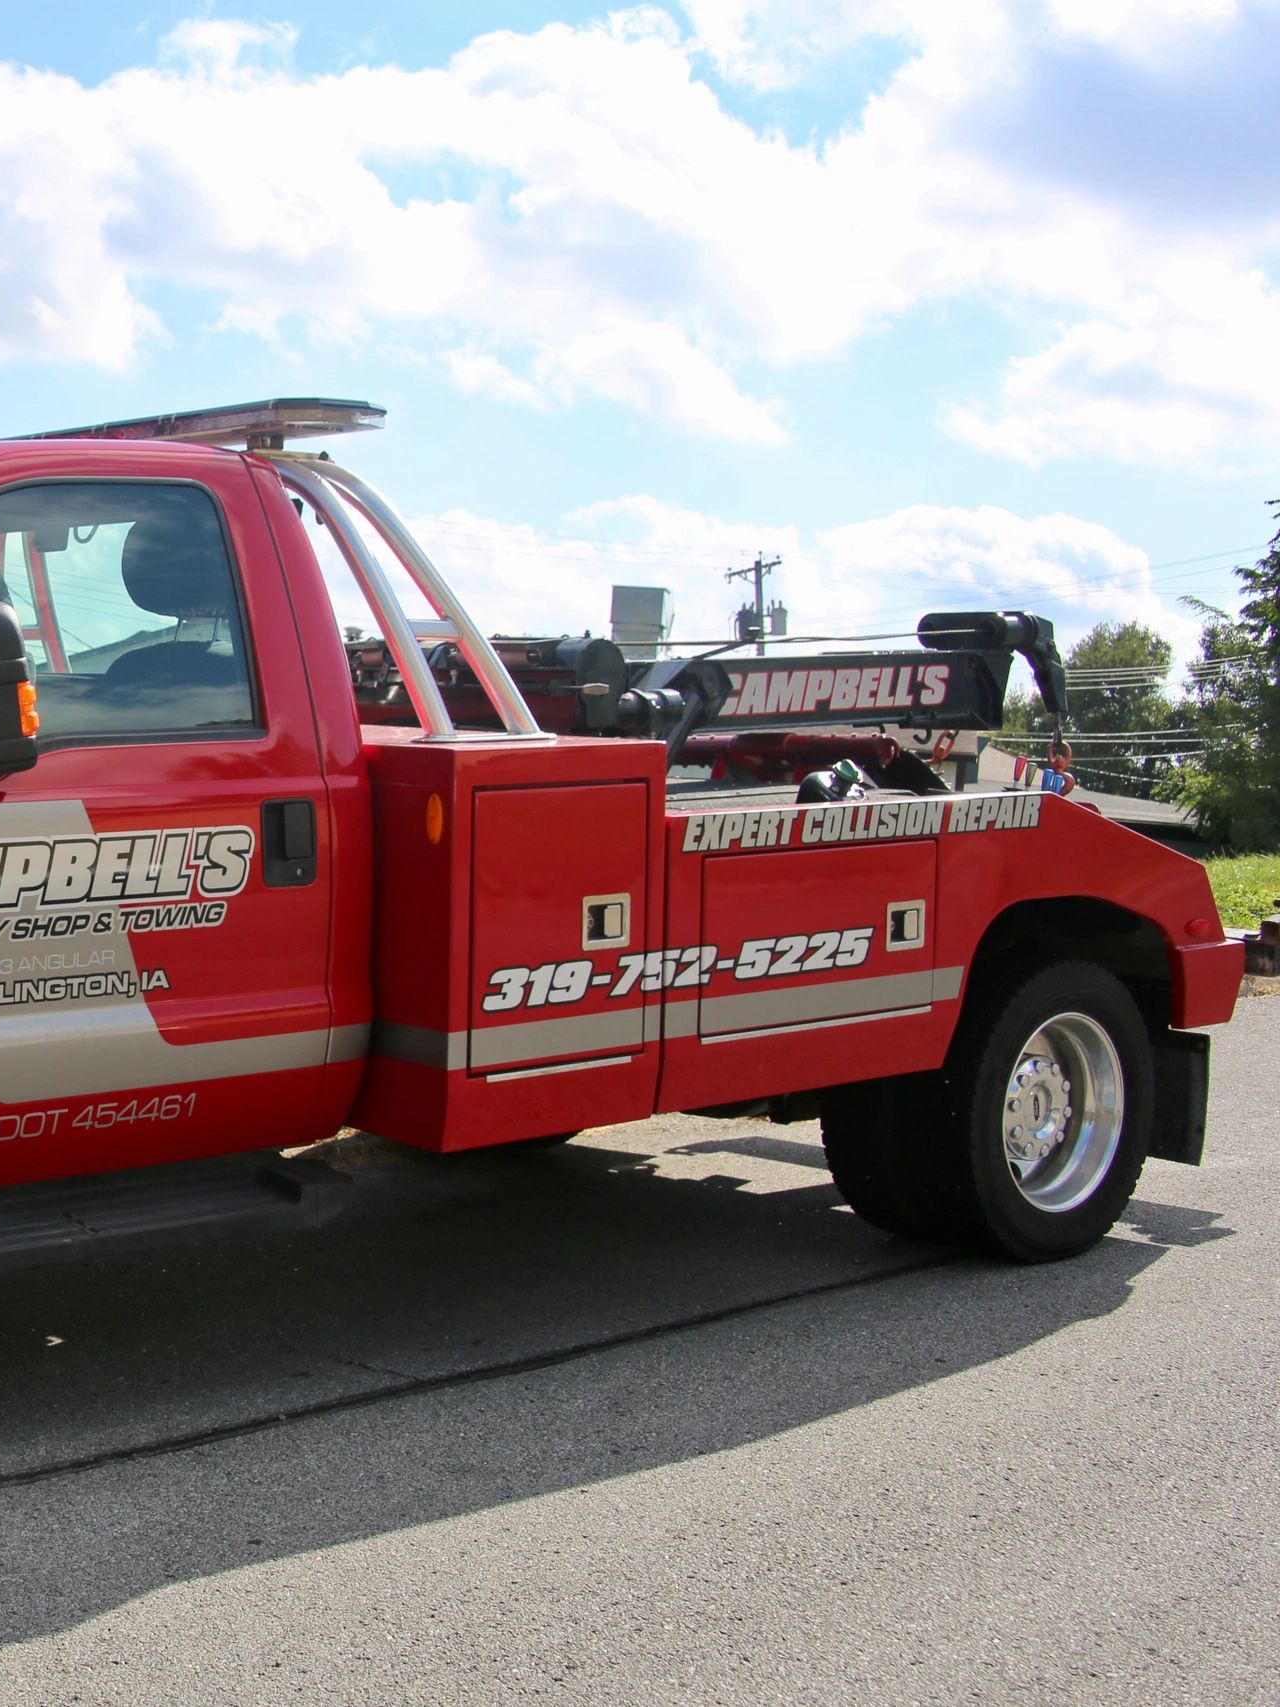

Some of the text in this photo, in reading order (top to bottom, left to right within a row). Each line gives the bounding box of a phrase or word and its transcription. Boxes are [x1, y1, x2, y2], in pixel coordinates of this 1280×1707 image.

[682, 795, 1041, 852] EXPERT COLLISION REPAIR
[10, 911, 90, 941] SHOP
[92, 911, 113, 934] &
[118, 901, 227, 932] TOWING
[17, 950, 116, 973] ANGULAR
[140, 968, 172, 992] IA
[482, 928, 874, 1012] 319-752-5225
[71, 1093, 197, 1130] 454461
